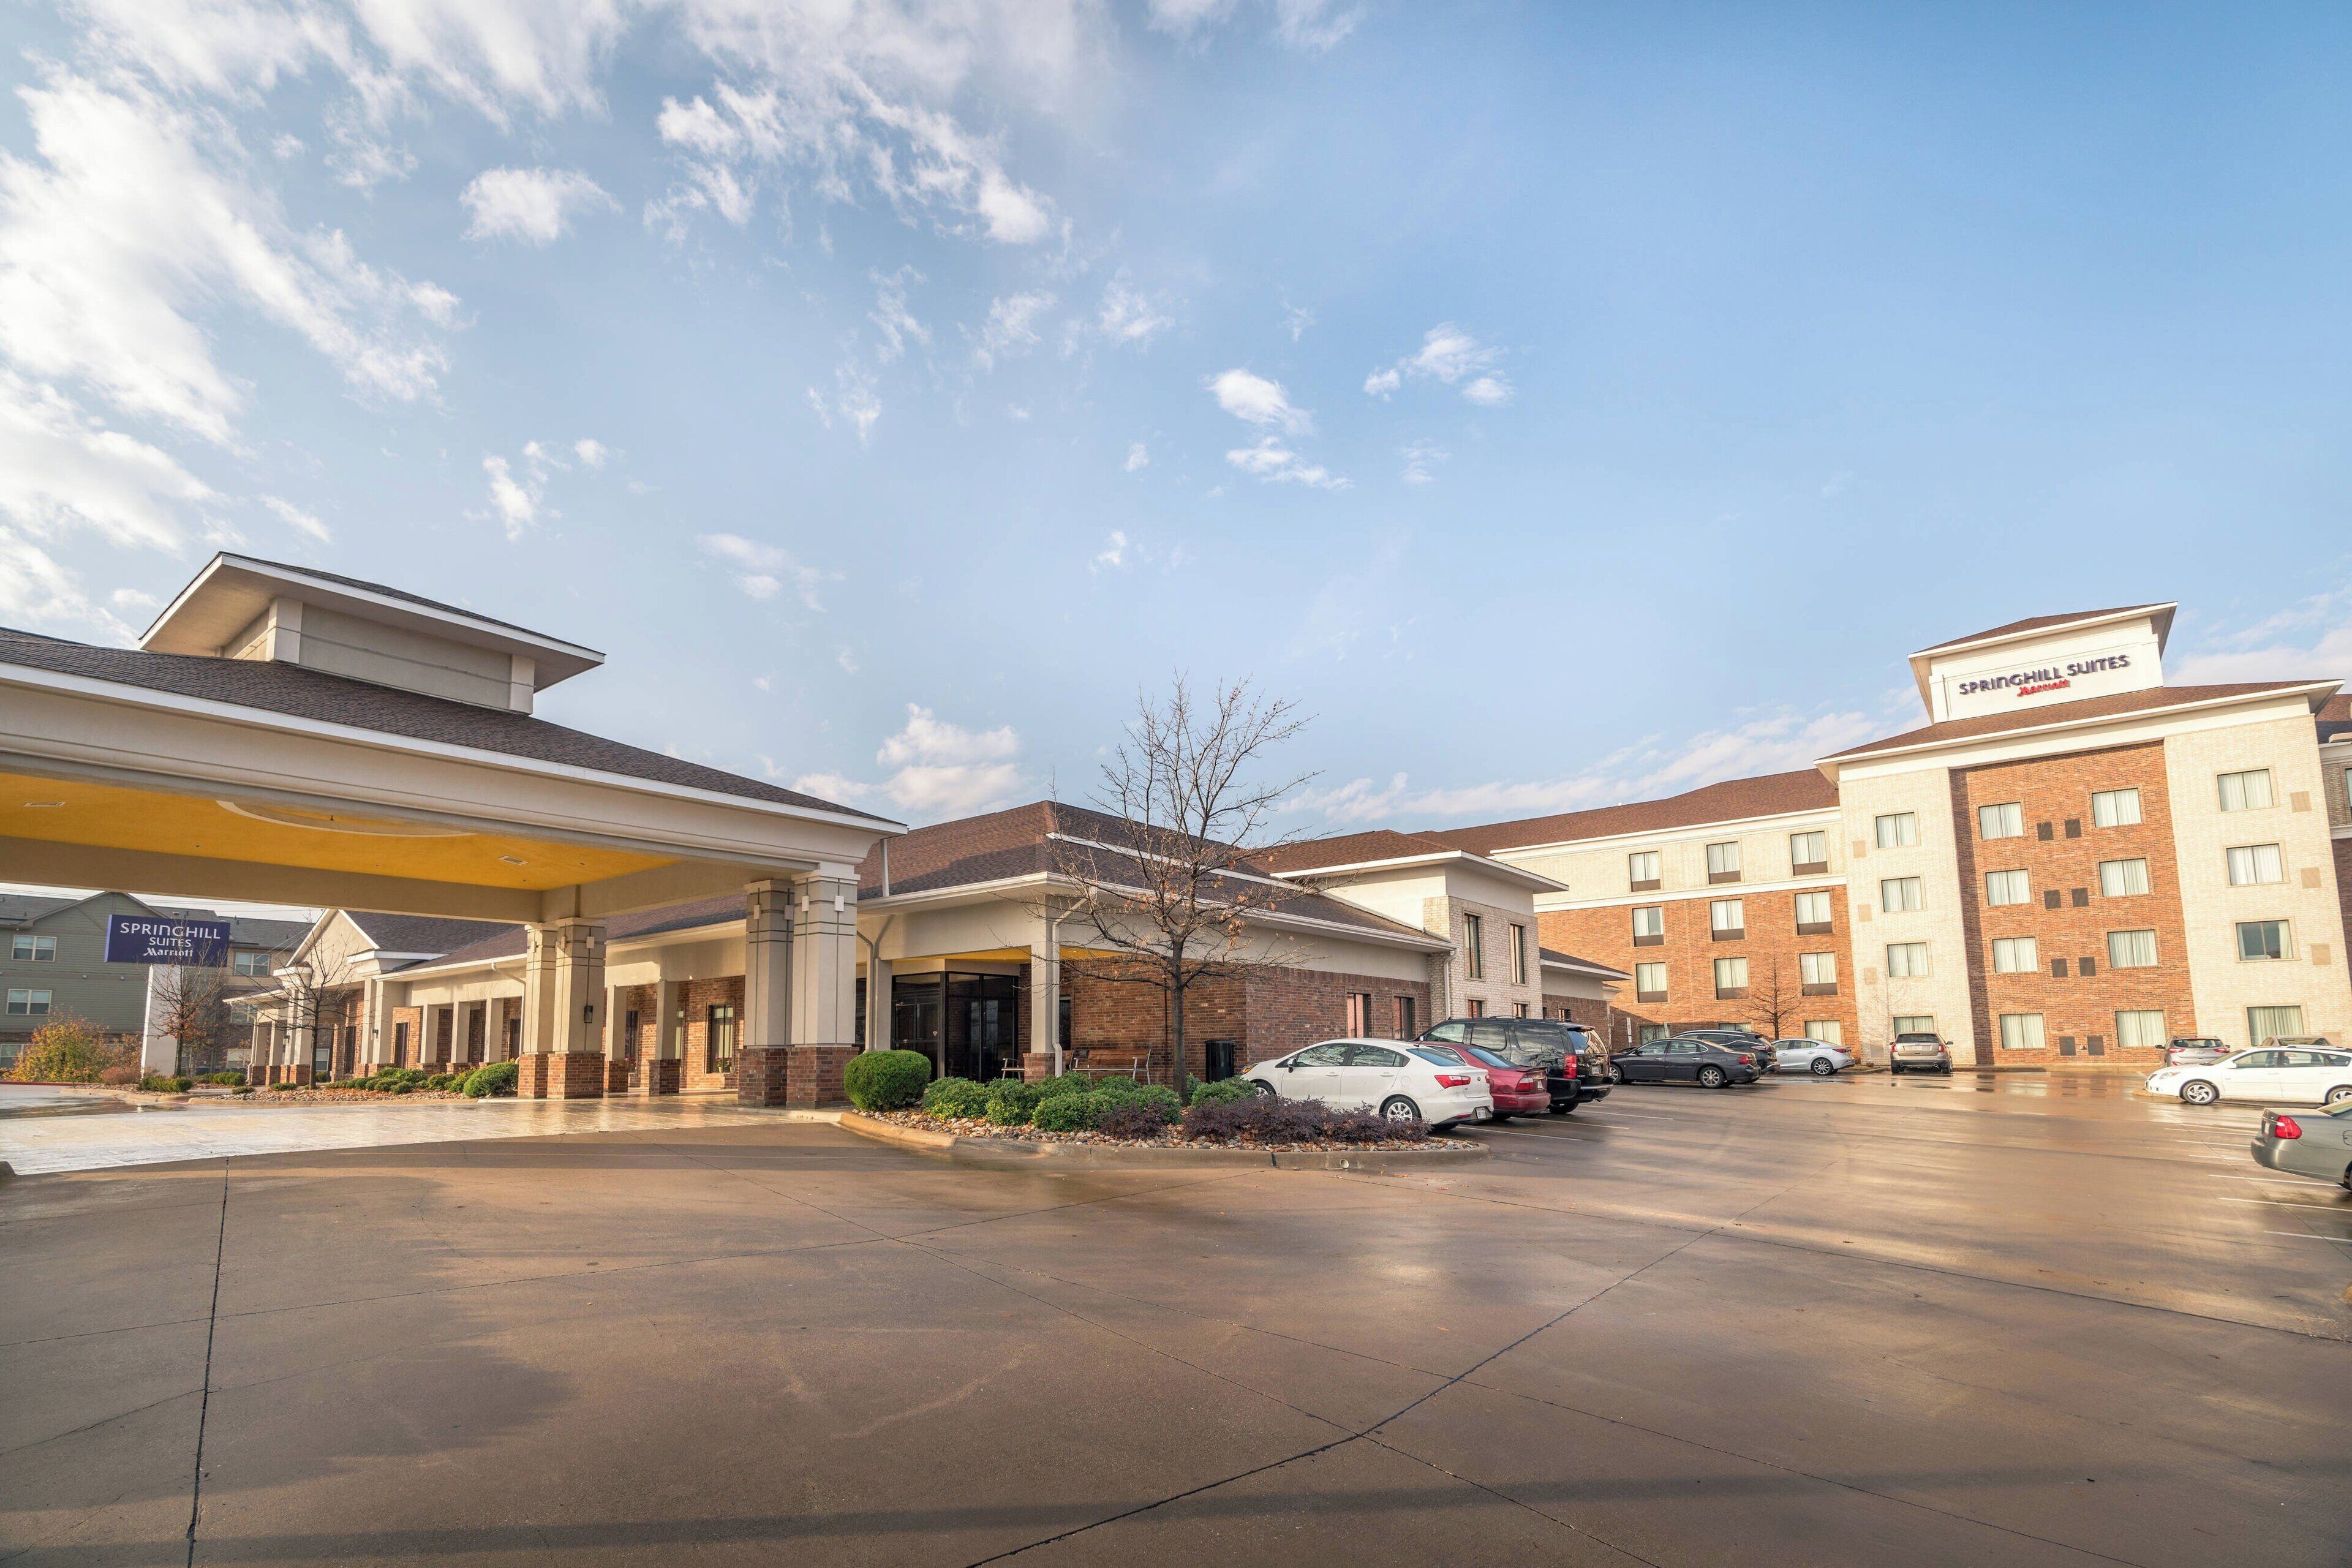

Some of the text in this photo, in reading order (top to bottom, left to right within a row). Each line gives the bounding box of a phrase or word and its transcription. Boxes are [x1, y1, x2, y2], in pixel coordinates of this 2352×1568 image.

[1959, 655, 2130, 695] SPRINGHILL SUITES
[120, 922, 221, 939] SPRINGHILL
[149, 937, 192, 948] SUITES
[143, 948, 194, 957] Marriott
